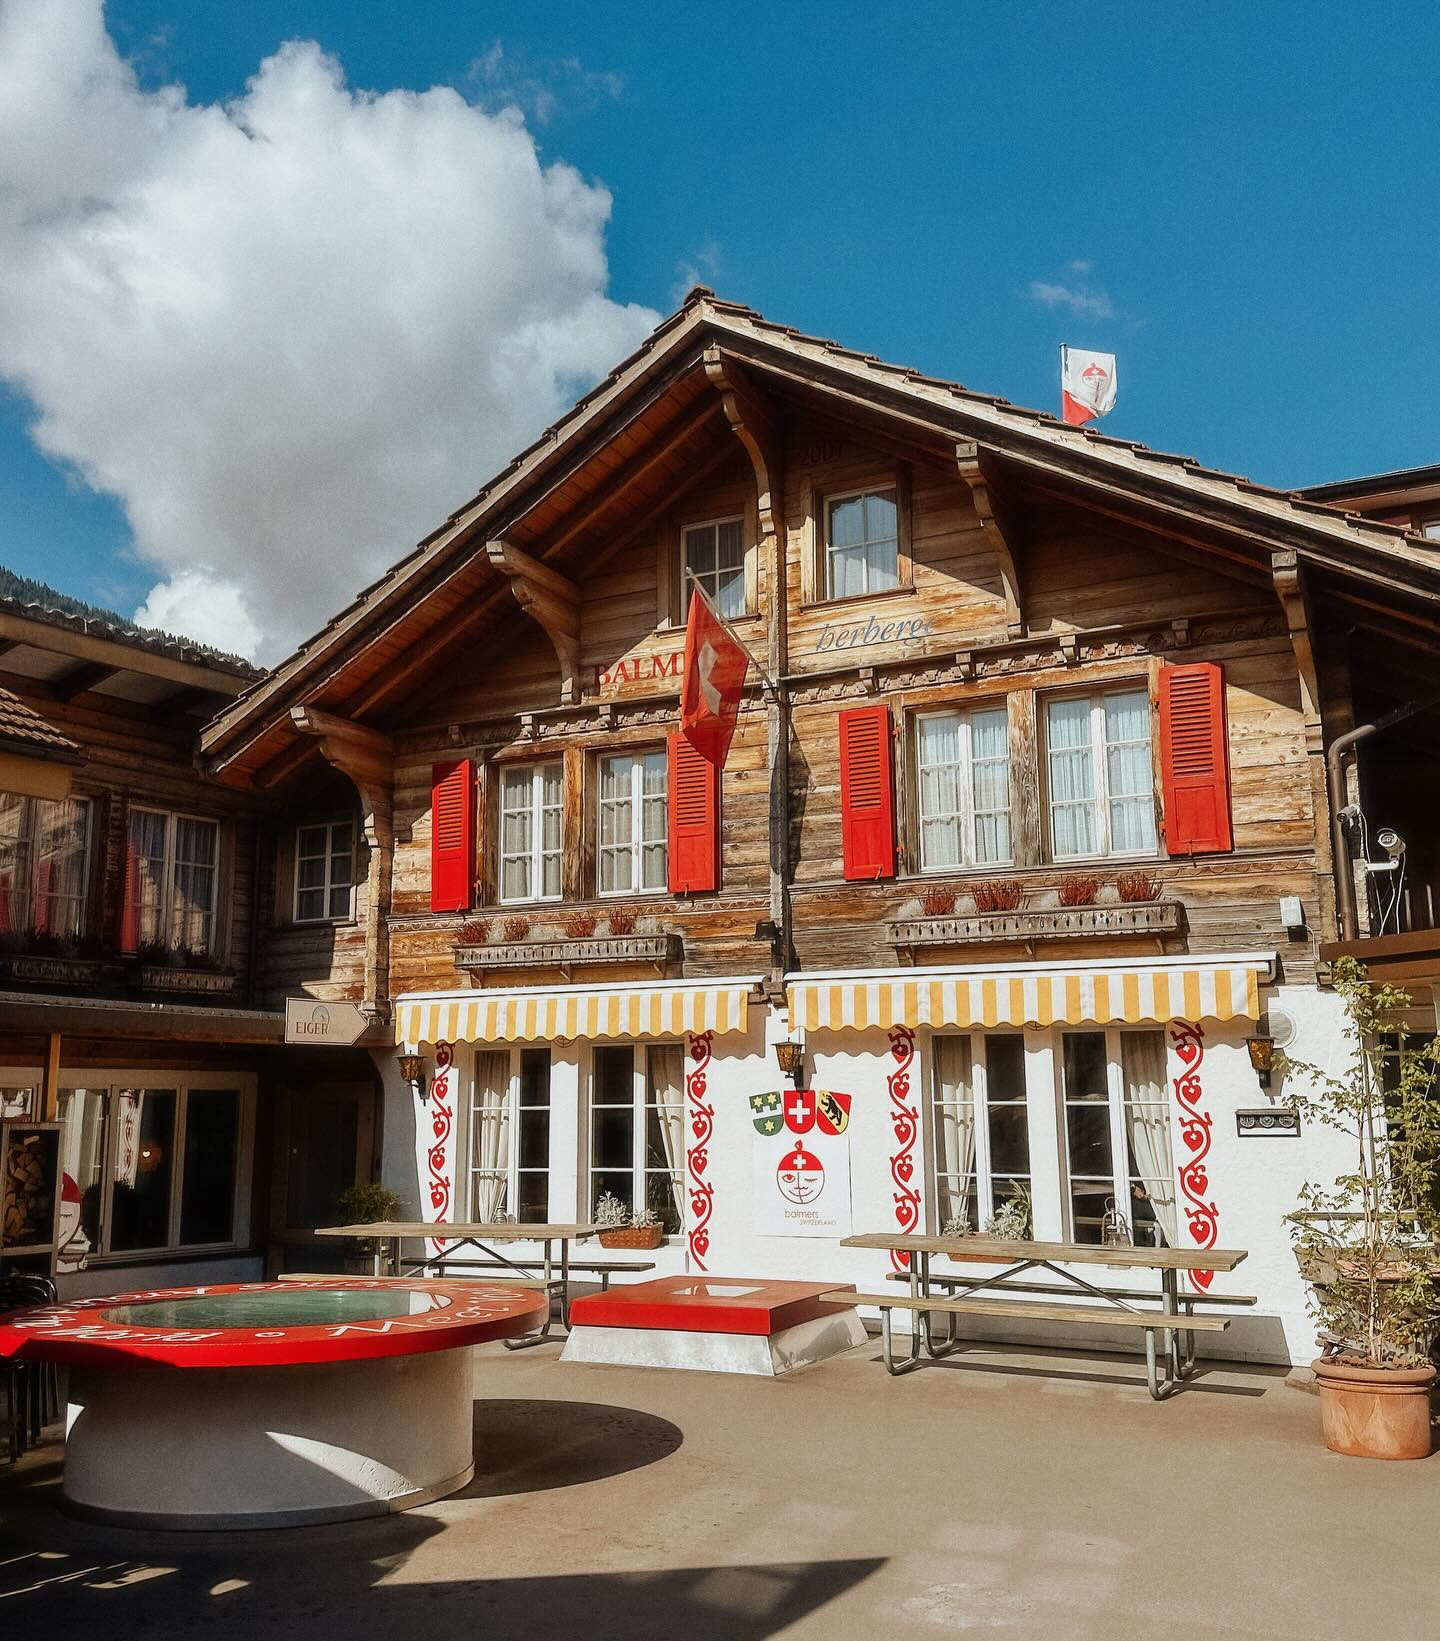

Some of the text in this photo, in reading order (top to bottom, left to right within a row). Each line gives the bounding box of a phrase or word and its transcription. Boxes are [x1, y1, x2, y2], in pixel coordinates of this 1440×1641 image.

[594, 651, 685, 686] BALM
[295, 1021, 329, 1035] EIGER
[784, 1209, 819, 1219] balmers
[37, 1325, 224, 1342] World
